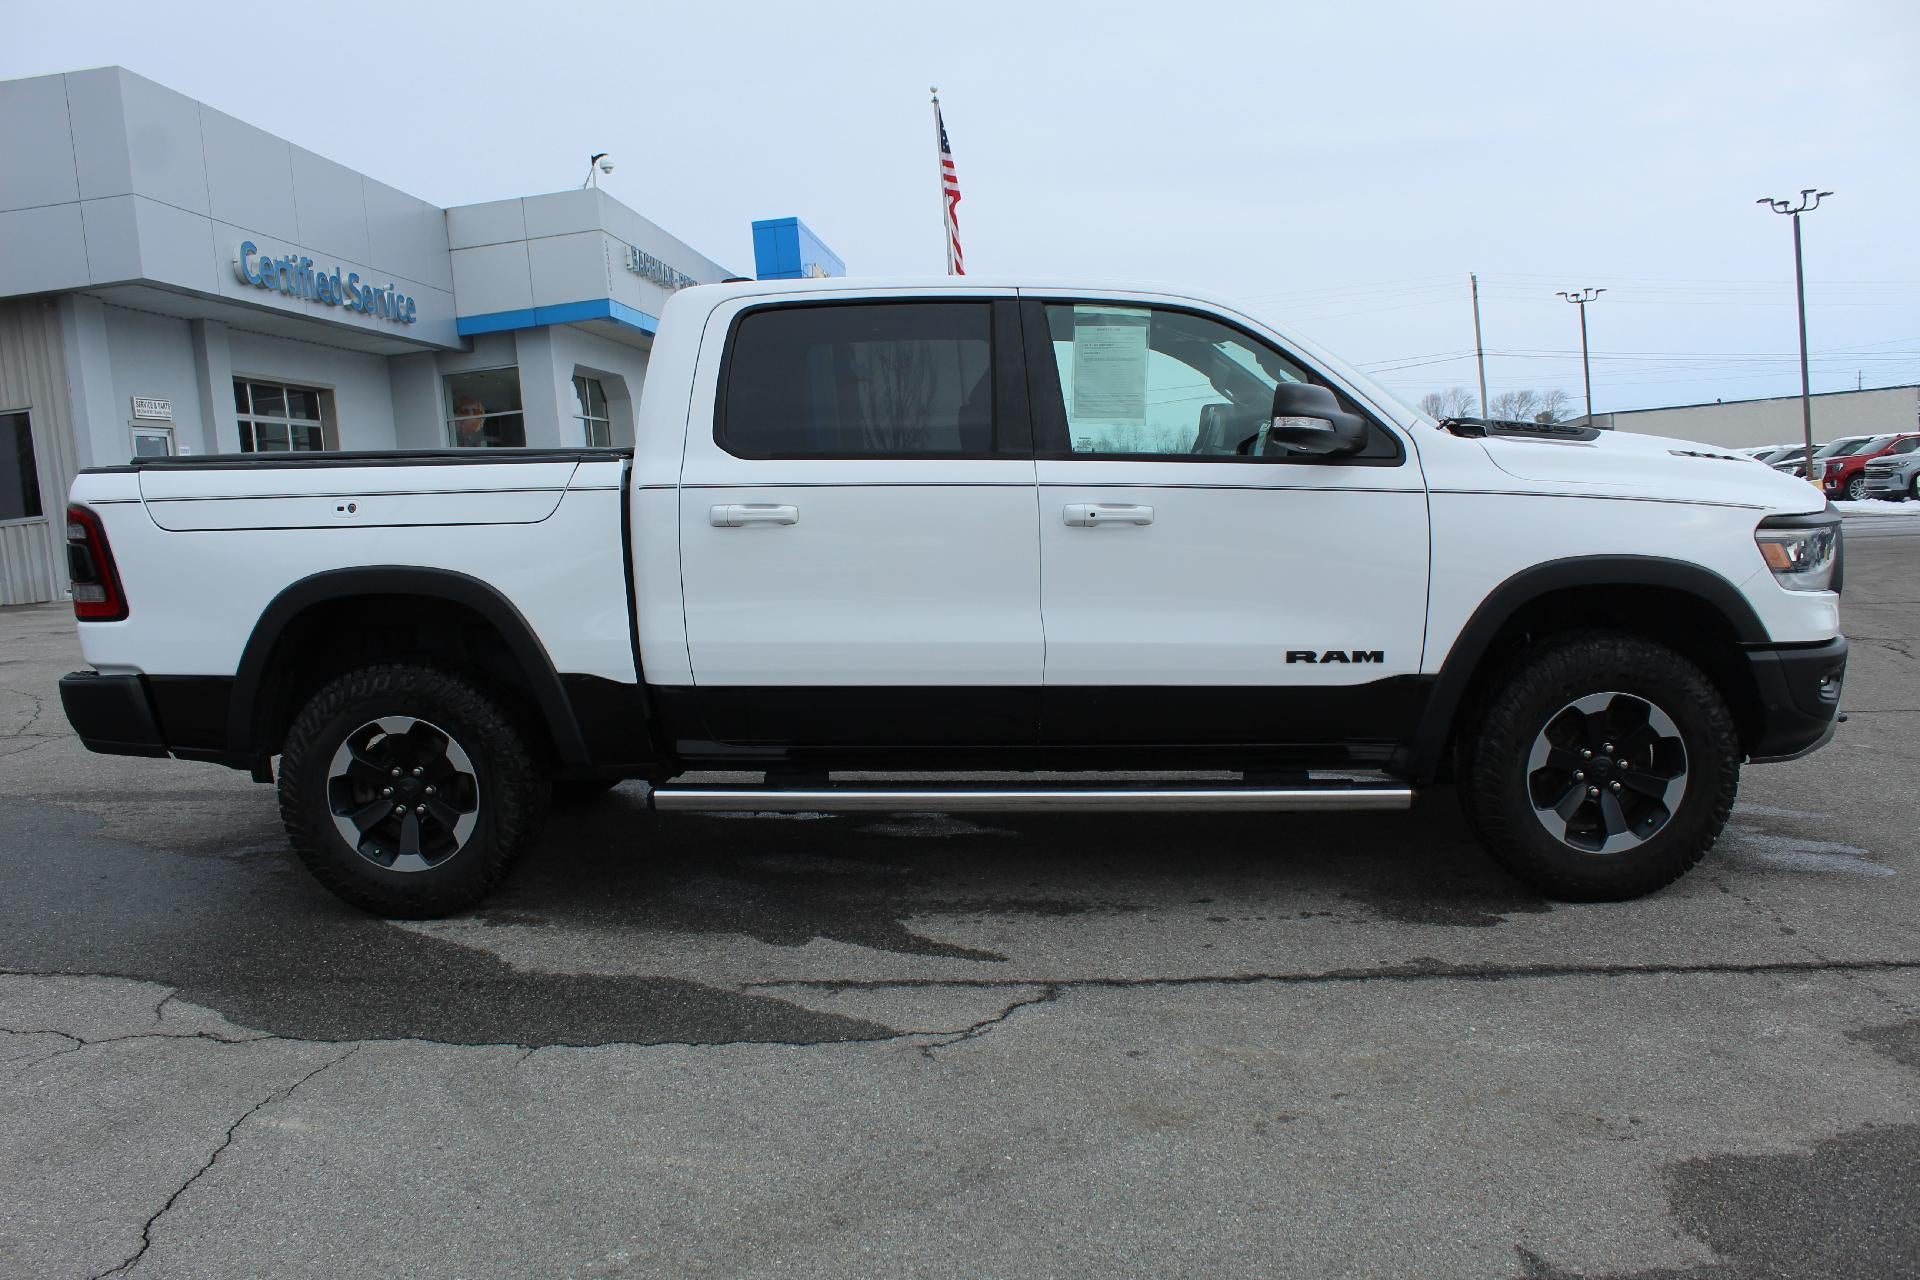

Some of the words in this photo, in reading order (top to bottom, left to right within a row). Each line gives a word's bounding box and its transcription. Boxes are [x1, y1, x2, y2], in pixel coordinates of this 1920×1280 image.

[237, 240, 343, 306] Certified
[346, 272, 416, 324] Service
[1286, 650, 1384, 663] RAM
